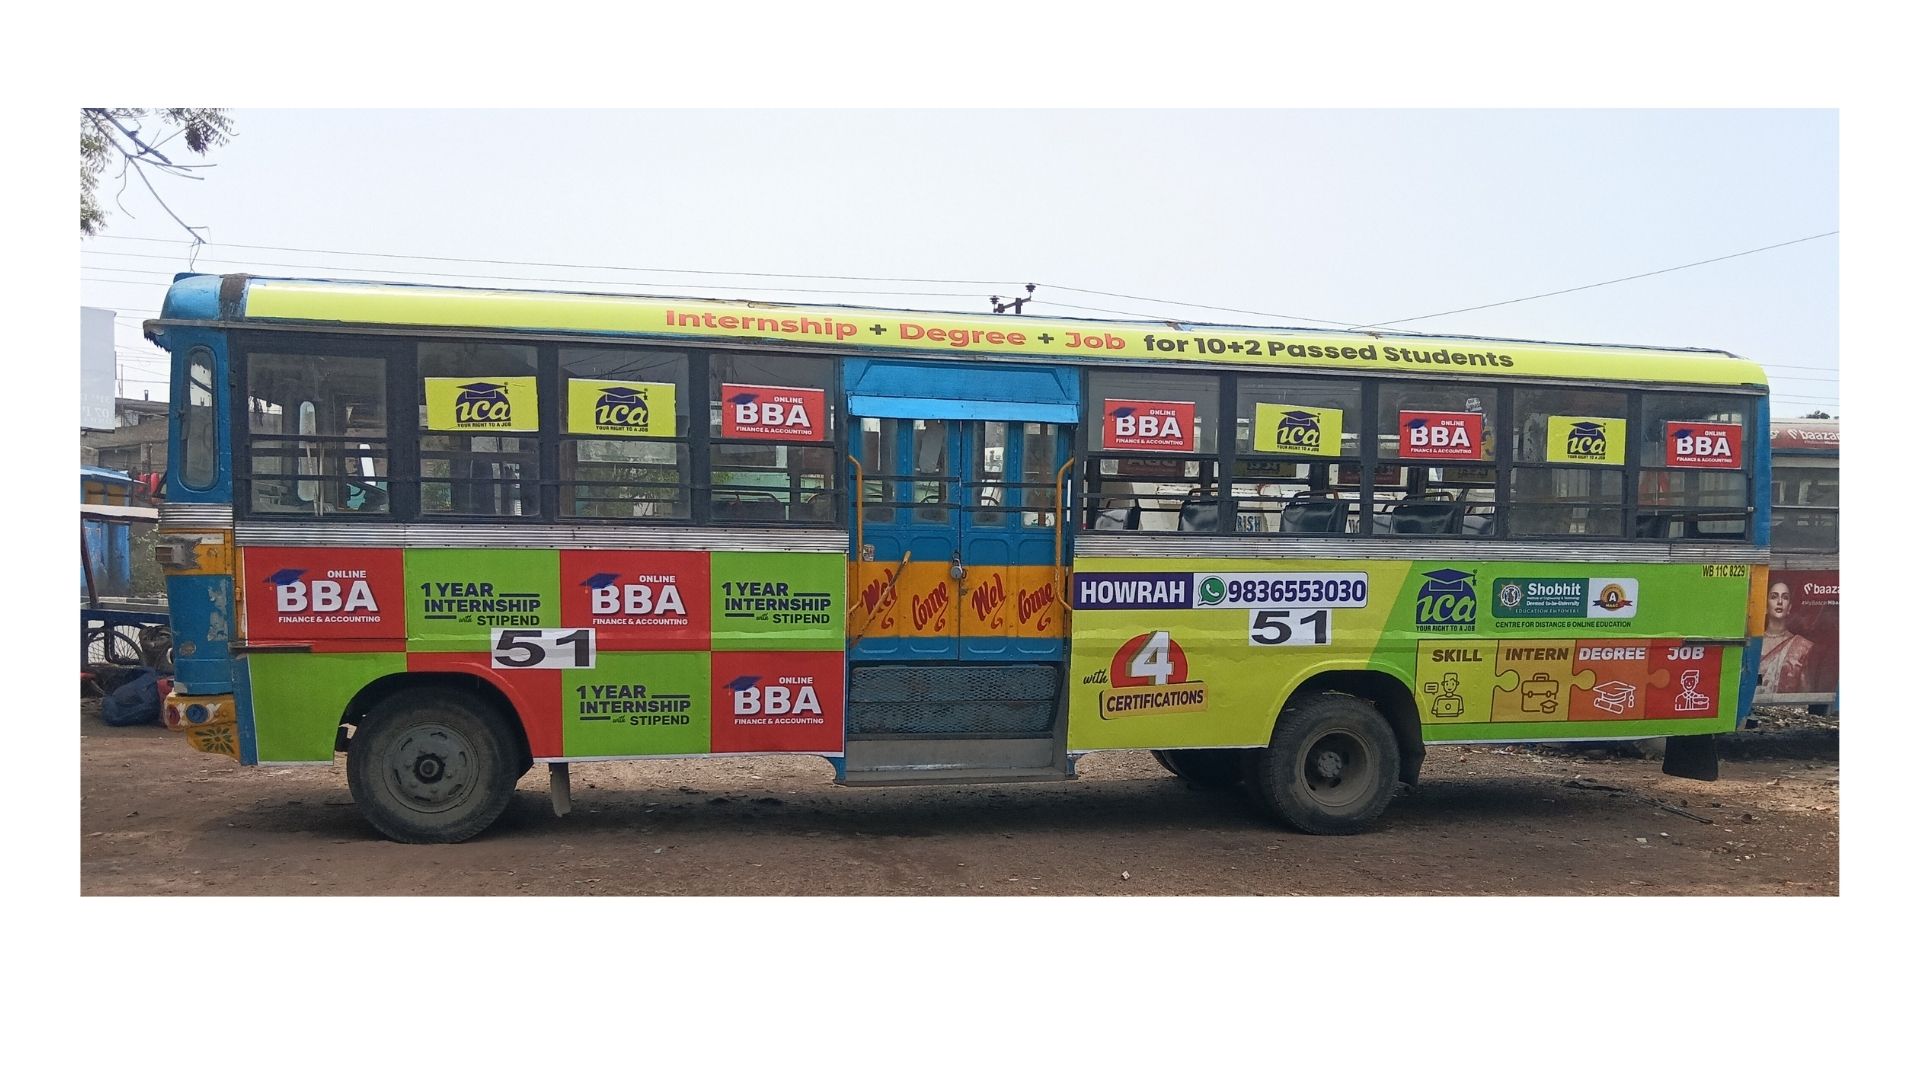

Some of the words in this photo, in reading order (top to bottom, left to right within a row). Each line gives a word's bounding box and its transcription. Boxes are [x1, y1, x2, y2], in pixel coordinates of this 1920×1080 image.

[666, 310, 858, 341] Internship
[869, 324, 888, 336] +
[899, 323, 1027, 348] Degree
[1037, 332, 1055, 345] +
[1065, 332, 1126, 351] Job
[1144, 334, 1188, 352] for
[1195, 337, 1262, 356] 10+2
[1268, 340, 1377, 361] Passed
[1385, 346, 1515, 368] Students
[774, 396, 803, 404] ONLINE
[456, 401, 511, 421] ica
[595, 404, 648, 425] ica
[736, 402, 811, 427] BBA
[1116, 415, 1182, 438] BBA
[1277, 426, 1319, 445] ica
[1410, 425, 1470, 447] BBA
[1568, 437, 1605, 454] ica
[1677, 436, 1731, 456] BBA
[327, 570, 367, 578] ONLINE
[639, 575, 676, 583] ONLINE
[1702, 565, 1714, 577] WB
[276, 580, 378, 612] BBA
[420, 582, 431, 597] 1
[435, 582, 494, 597] YEAR
[721, 582, 731, 596] 1
[736, 582, 789, 596] YEAR
[1081, 581, 1185, 604] HOWRAH
[1228, 580, 1366, 602] 9836553030
[1527, 583, 1581, 596] Shobhit
[1609, 592, 1617, 602] A
[424, 599, 541, 613] INTERNSHIP
[592, 584, 686, 615] BBA
[725, 598, 831, 611] INTERNSHIP
[1417, 595, 1476, 622] ica
[324, 615, 380, 623] ACCOUNTING
[477, 615, 540, 626] STIPEND
[773, 613, 830, 624] STIPEND
[1251, 610, 1328, 645] 51
[495, 629, 590, 667] 51
[1432, 649, 1483, 662] SKILL
[1506, 648, 1569, 661] INTERN
[1578, 647, 1646, 660] DEGREE
[1667, 647, 1705, 660] JOB
[1083, 670, 1108, 685] with
[1128, 631, 1175, 685] 4
[779, 676, 813, 684] ONLINE
[576, 685, 586, 699] 1
[591, 685, 646, 699] YEAR
[734, 686, 822, 714] BBA
[580, 700, 691, 713] INTERNSHIP
[1106, 690, 1204, 712] CERTIFICATIONS
[630, 715, 690, 726] STIPEND
